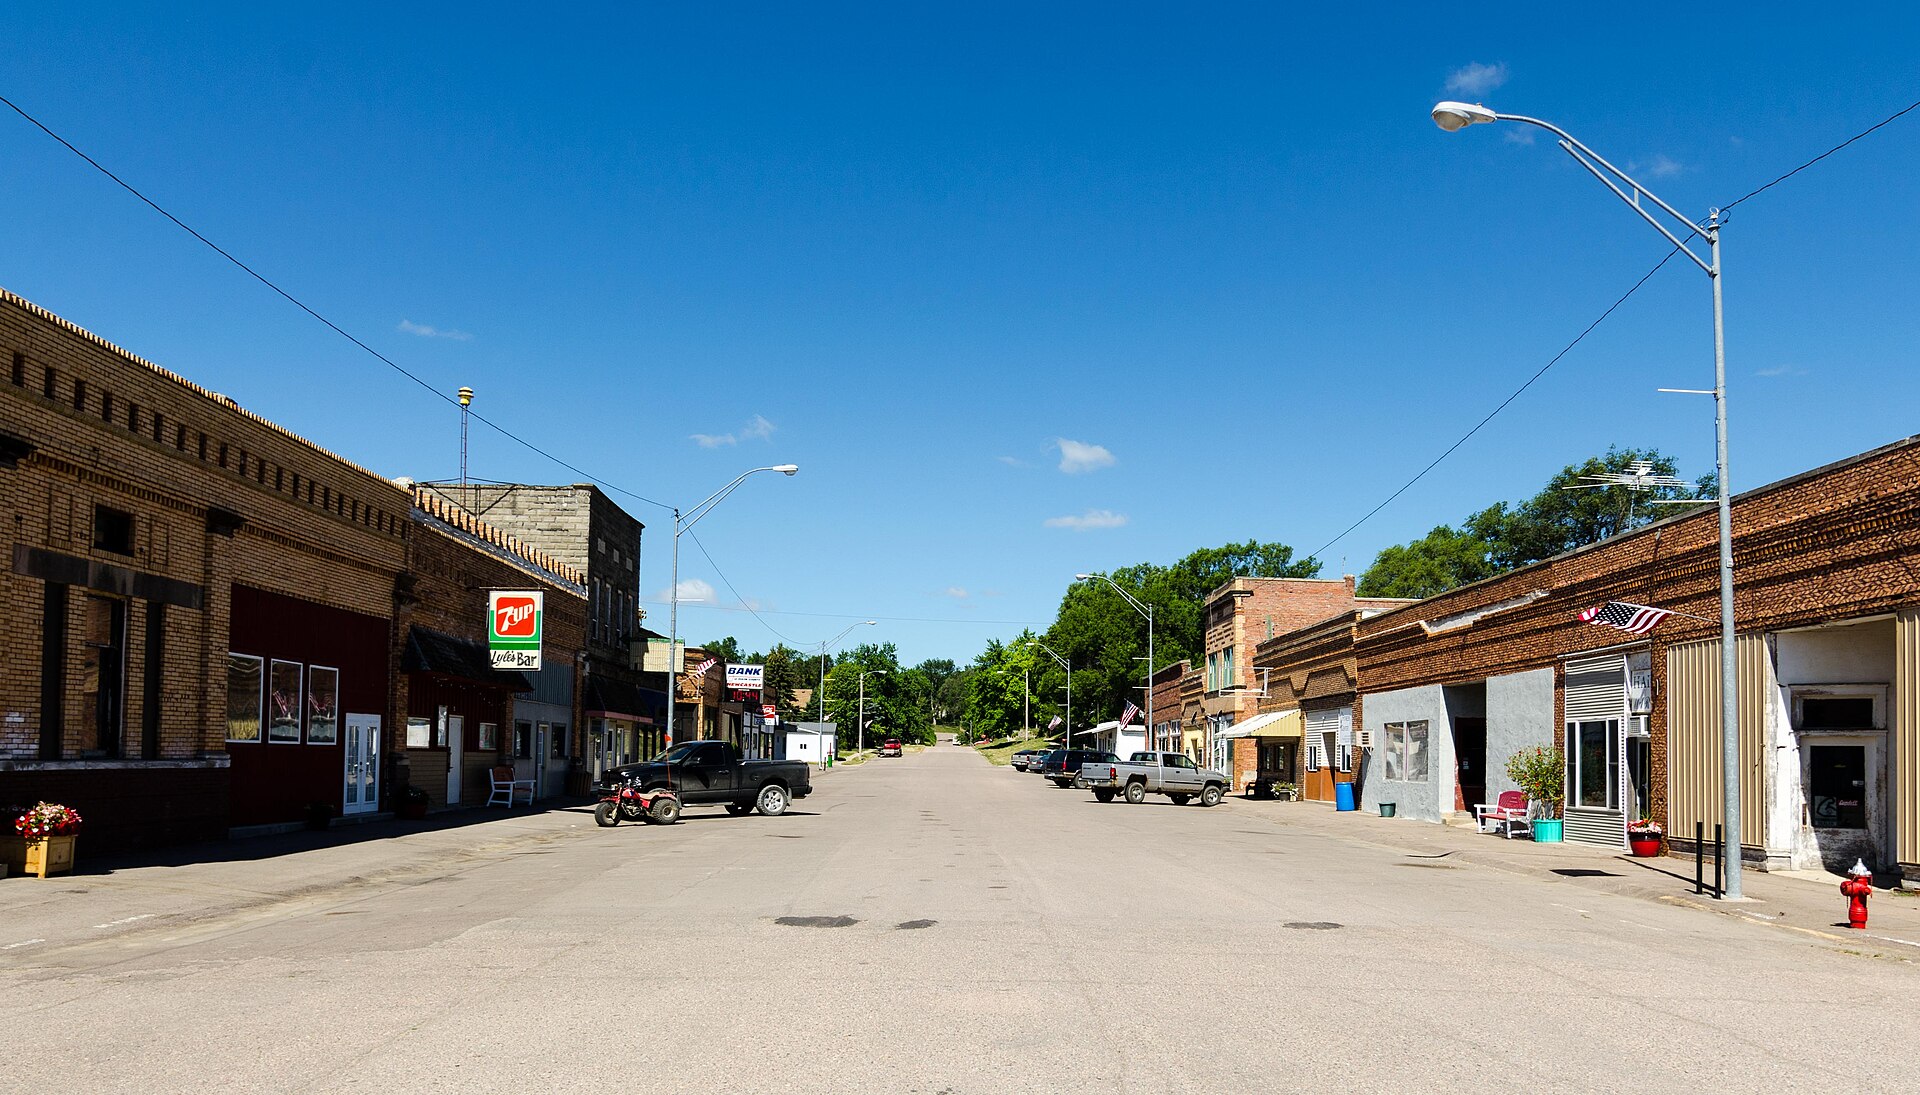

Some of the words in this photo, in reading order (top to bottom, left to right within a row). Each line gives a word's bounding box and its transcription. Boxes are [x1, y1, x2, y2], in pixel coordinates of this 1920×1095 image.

[491, 650, 516, 667] Lyle's
[517, 652, 537, 666] Bar
[728, 667, 762, 675] BANK
[732, 690, 759, 701] 10:44
